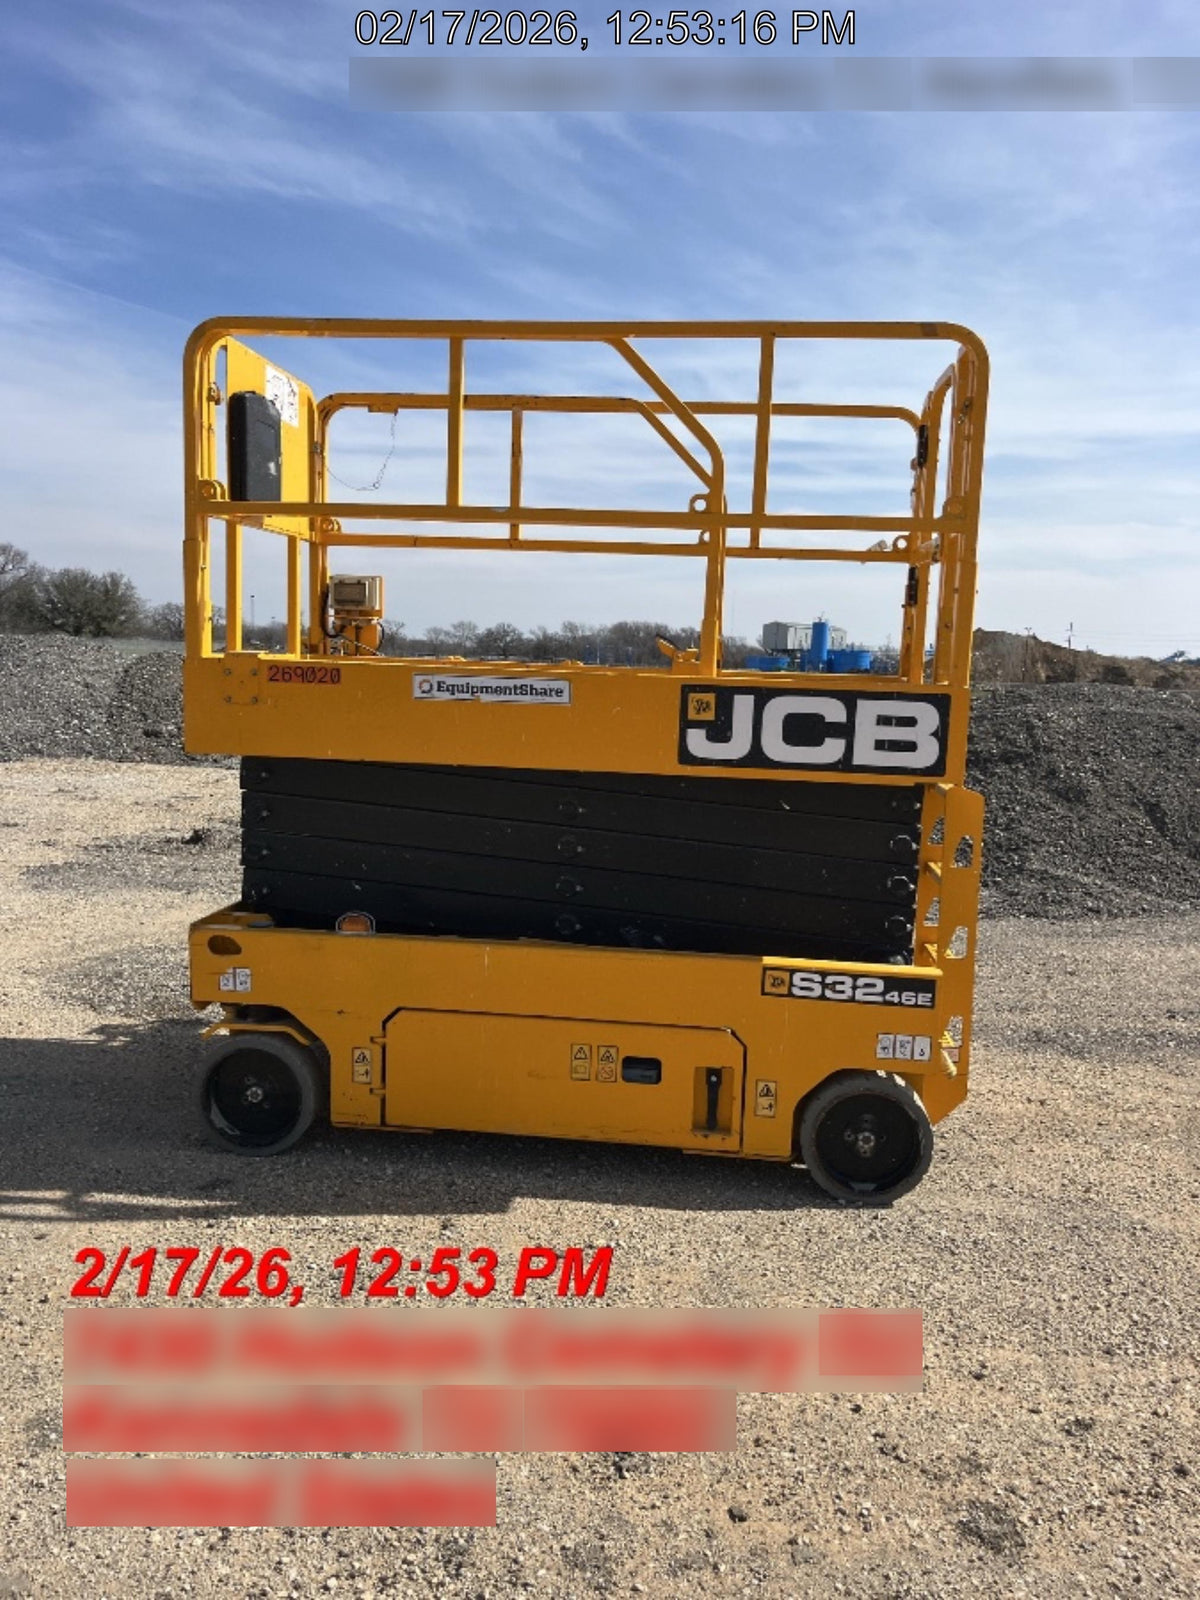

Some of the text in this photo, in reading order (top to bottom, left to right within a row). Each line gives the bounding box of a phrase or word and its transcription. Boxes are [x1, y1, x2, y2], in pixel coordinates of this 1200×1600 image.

[268, 665, 341, 684] 269020
[436, 680, 565, 698] EquipmentShare
[685, 694, 940, 769] JCB
